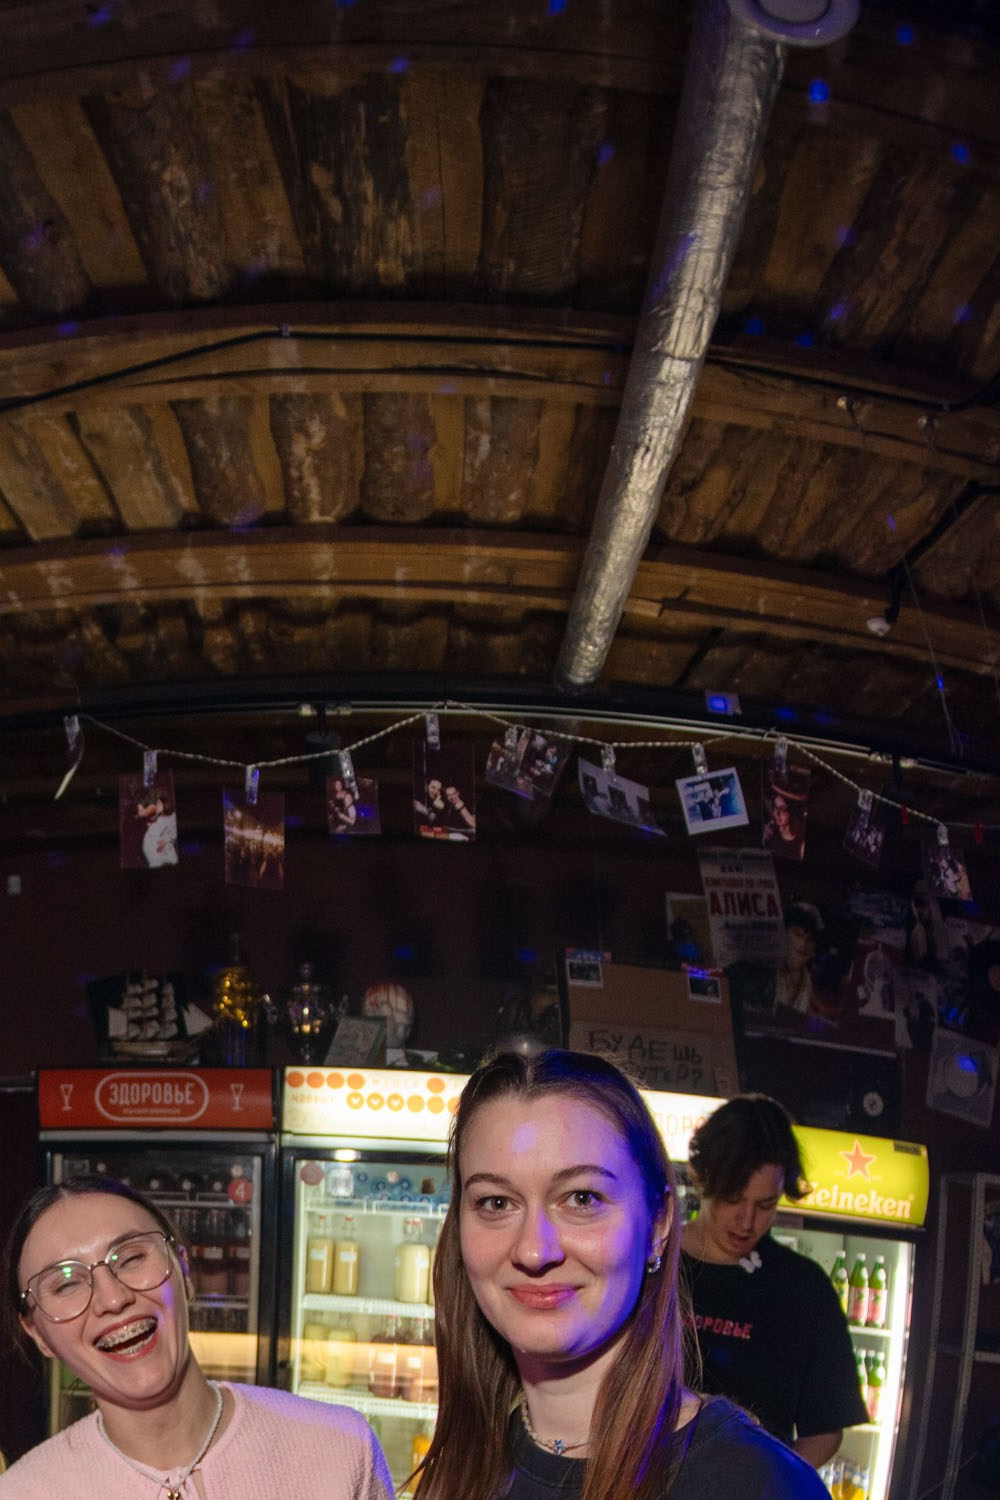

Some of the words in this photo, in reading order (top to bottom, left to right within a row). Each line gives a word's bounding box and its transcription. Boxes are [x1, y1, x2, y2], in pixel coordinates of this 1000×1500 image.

[709, 890, 781, 917] АЛИСА
[109, 1082, 195, 1106] ЗДОРОВЬЕ
[235, 1182, 246, 1201] 4
[802, 1181, 912, 1219] eineken
